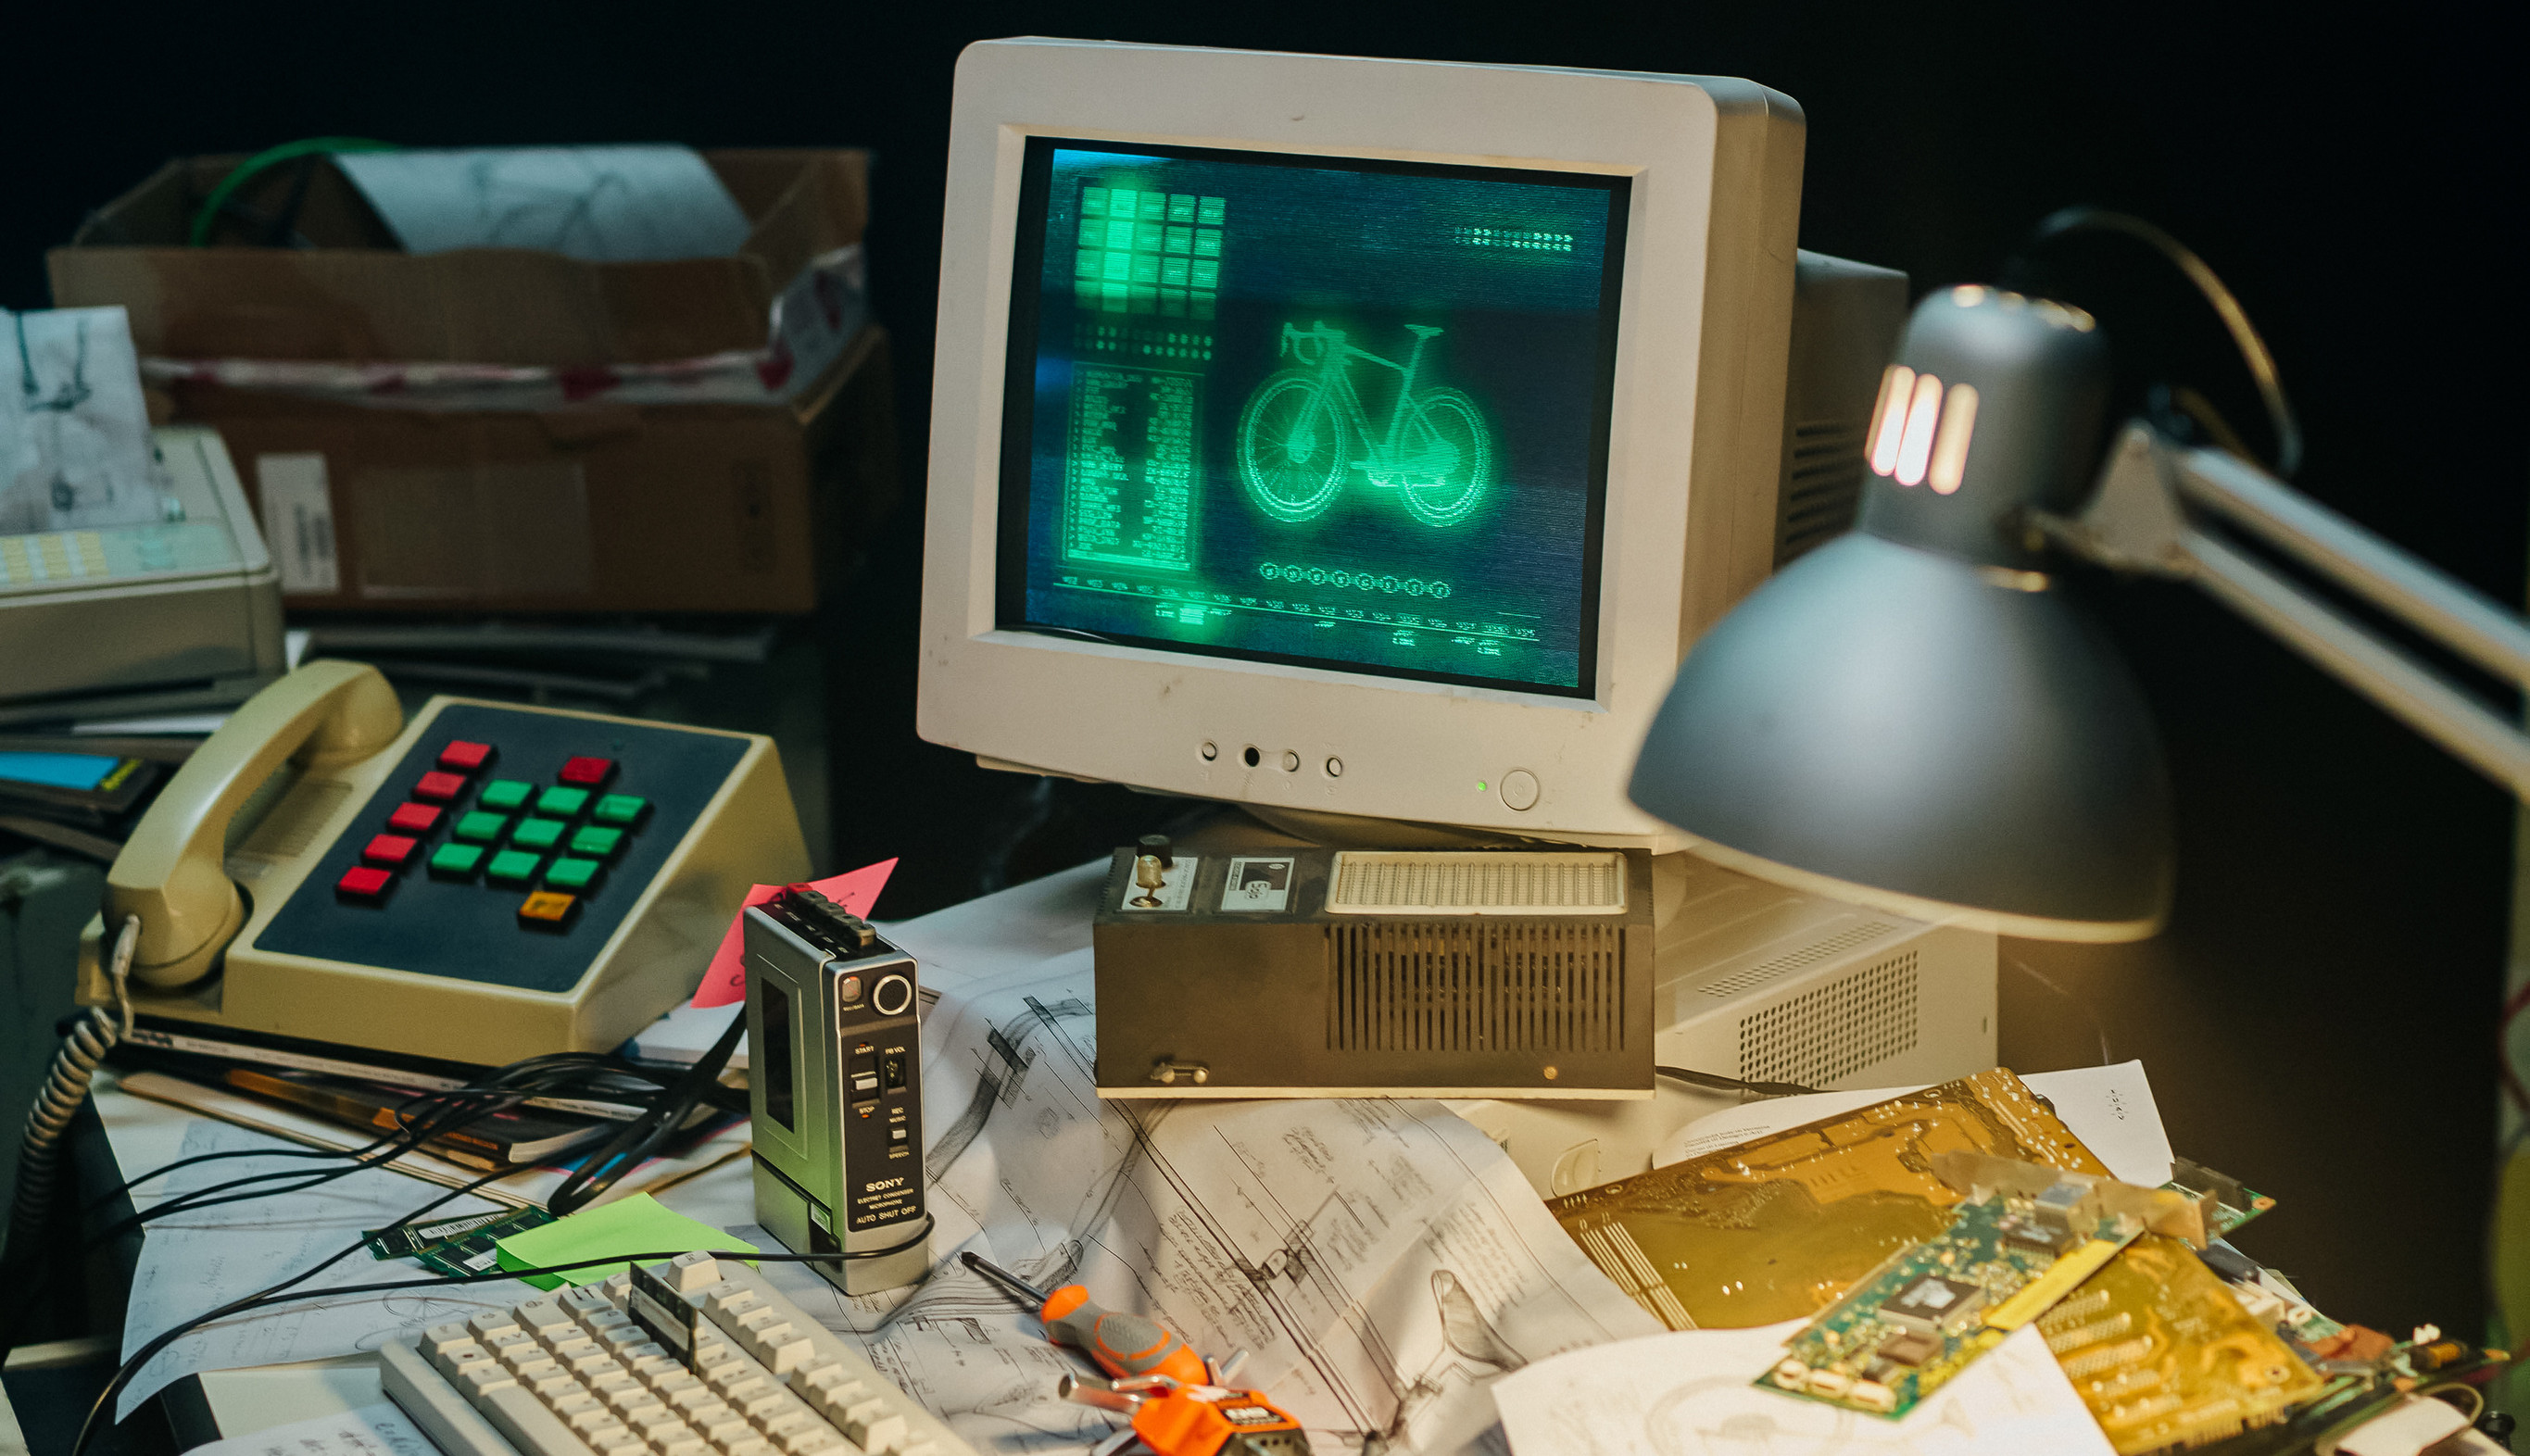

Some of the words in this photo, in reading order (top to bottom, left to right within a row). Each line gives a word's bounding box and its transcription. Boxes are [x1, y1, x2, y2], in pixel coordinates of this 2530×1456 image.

[854, 1045, 875, 1055] START
[894, 1046, 906, 1054] VOL
[859, 1105, 875, 1114] STOP
[891, 1107, 904, 1115] REC
[888, 1115, 907, 1123] MUSIC
[888, 1151, 910, 1160] SPEECH
[865, 1176, 905, 1192] SONY
[856, 1194, 882, 1205] ELECTRET
[883, 1187, 914, 1199] CONDENSER
[868, 1199, 903, 1210] MICROPHONE
[856, 1214, 876, 1224] AUTO
[878, 1209, 900, 1220] SHUT
[900, 1205, 916, 1215] OFF
